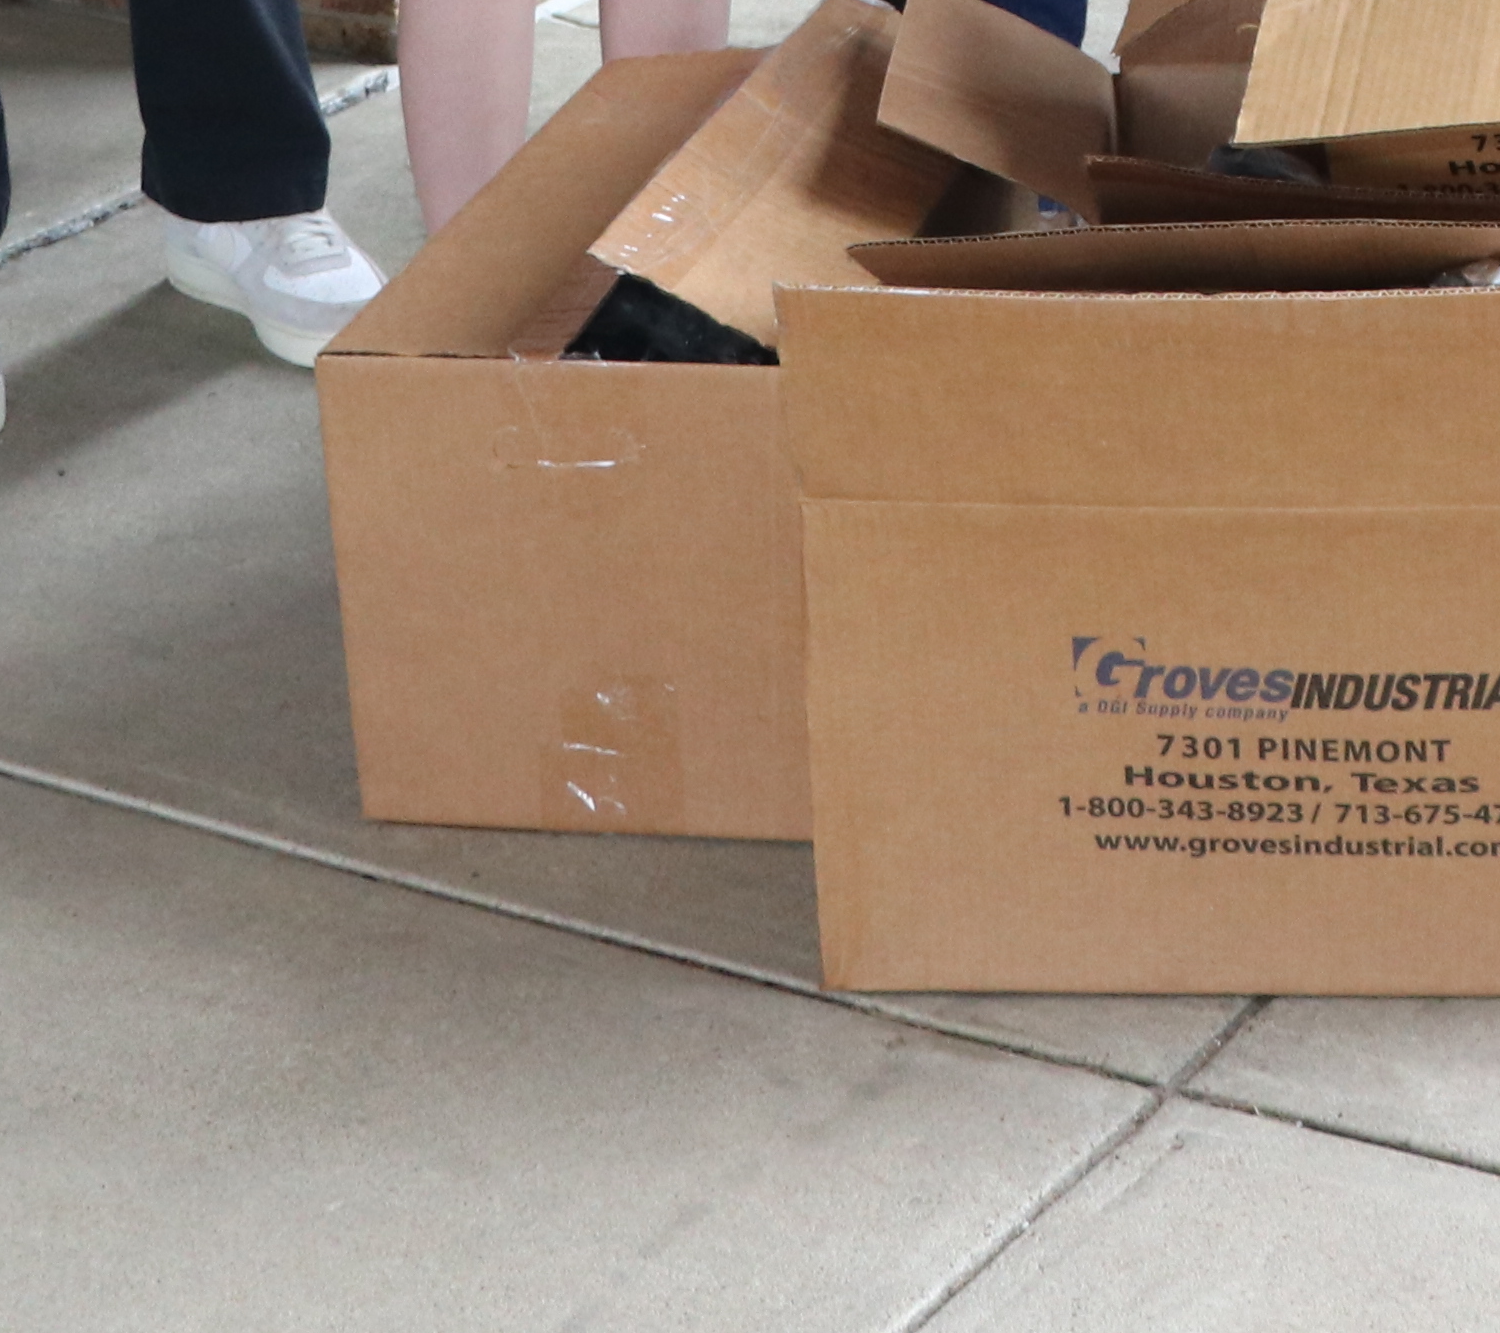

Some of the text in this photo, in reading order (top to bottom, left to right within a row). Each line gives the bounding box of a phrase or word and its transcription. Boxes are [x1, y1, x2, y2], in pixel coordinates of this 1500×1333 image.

[1136, 702, 1198, 721] Supply
[1205, 706, 1289, 723] company
[1156, 735, 1452, 763] 7301 PINEMONT
[1124, 766, 1481, 795] Houston, Texas
